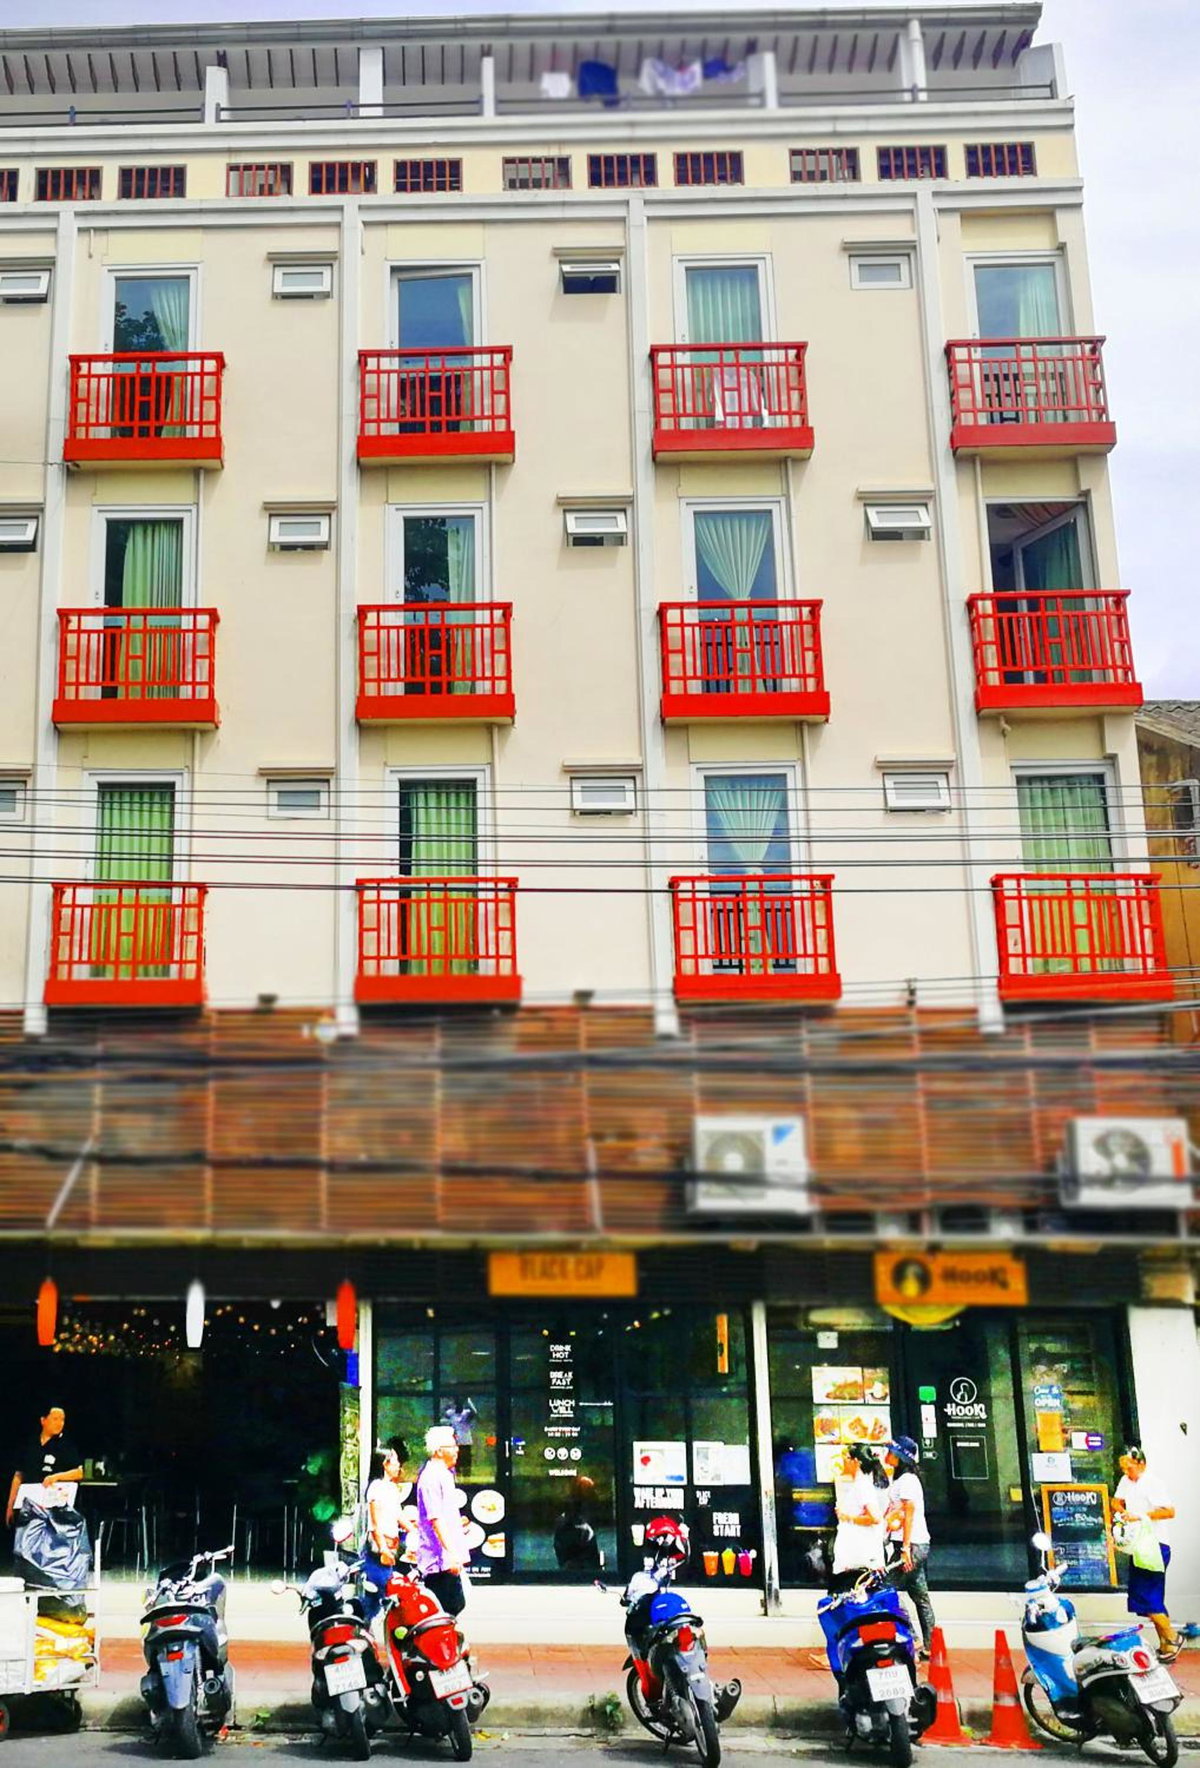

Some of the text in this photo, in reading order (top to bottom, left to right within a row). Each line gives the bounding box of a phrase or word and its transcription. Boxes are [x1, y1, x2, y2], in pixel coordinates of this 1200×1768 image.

[549, 1371, 573, 1379] BREAK
[548, 1399, 575, 1407] LUNCH
[712, 1525, 741, 1537] START
